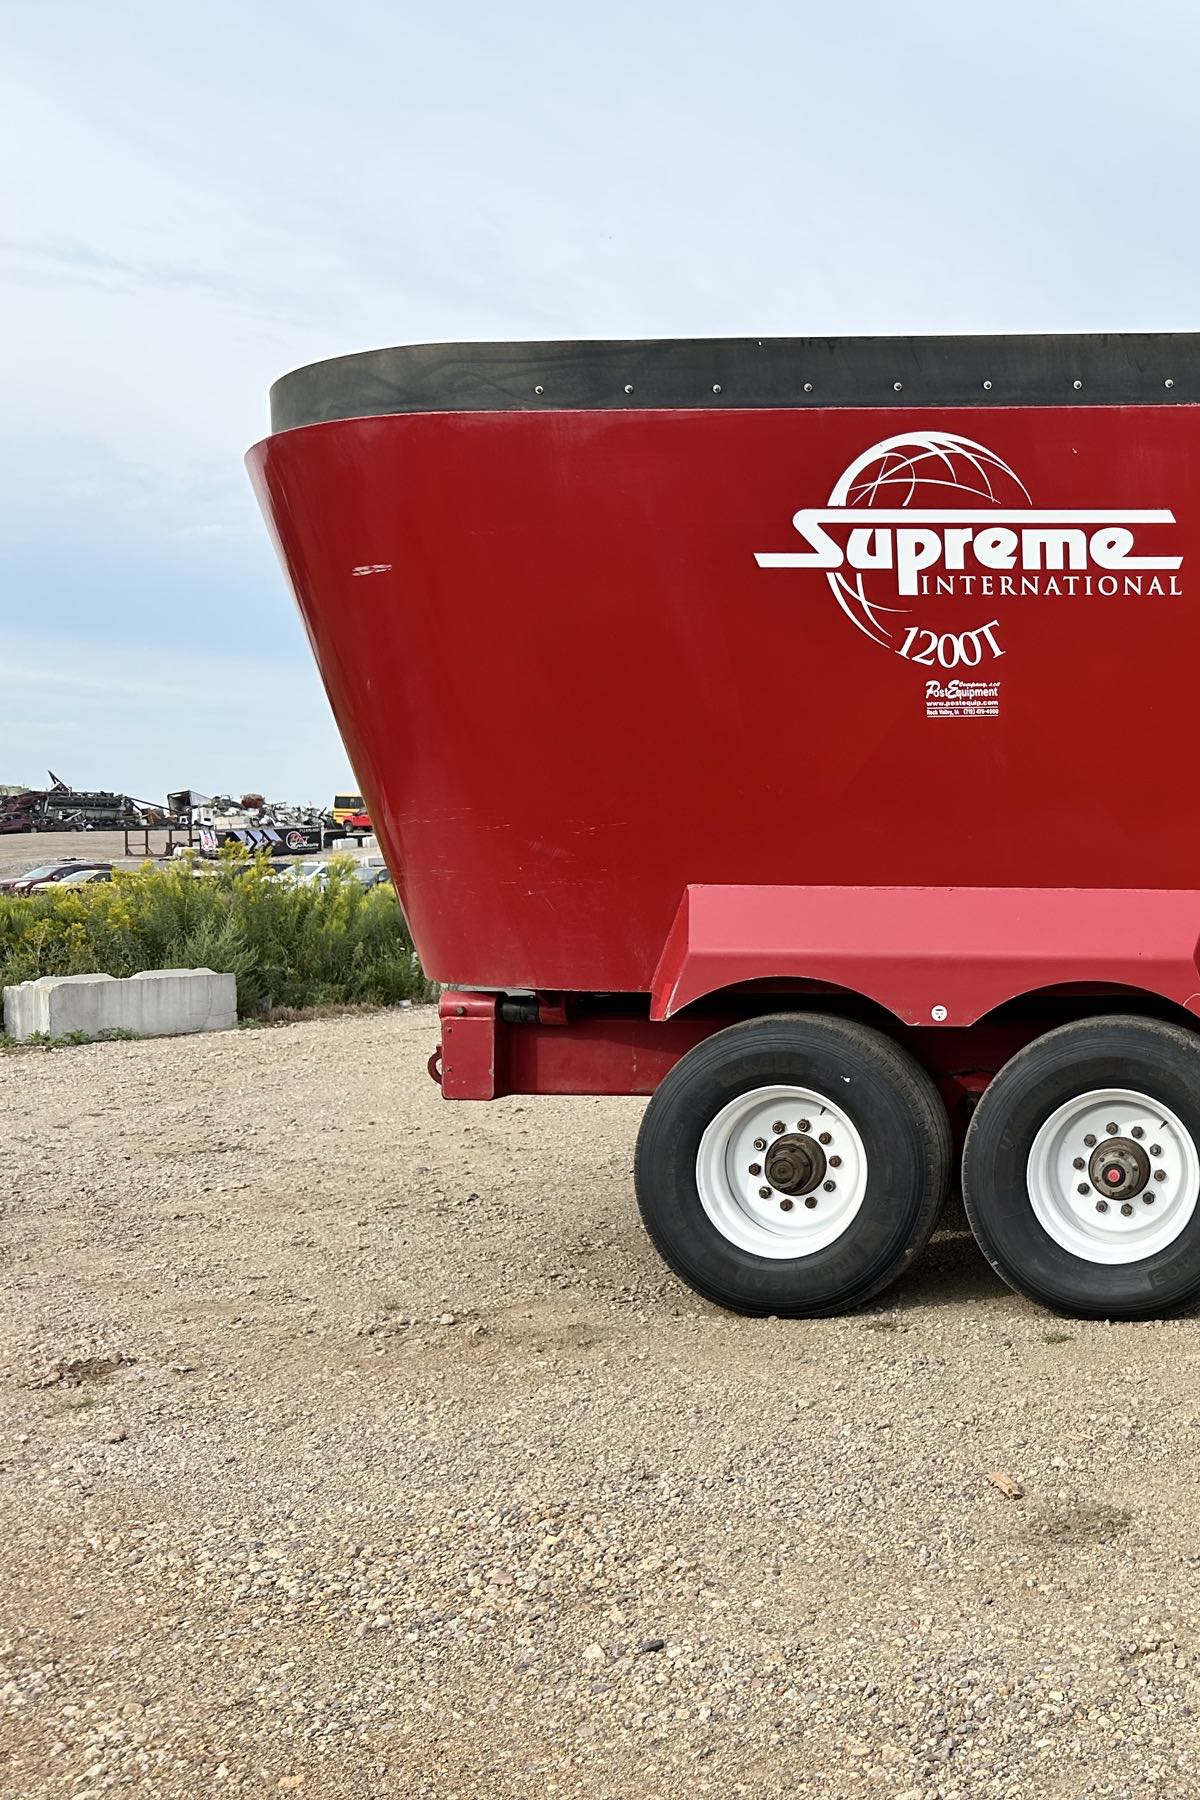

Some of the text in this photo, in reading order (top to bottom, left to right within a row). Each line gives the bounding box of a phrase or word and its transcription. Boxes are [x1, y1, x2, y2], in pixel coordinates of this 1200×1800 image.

[753, 508, 1184, 596] Supreme
[920, 574, 1183, 596] INTERNATIONAL
[895, 619, 1006, 669] 1200T
